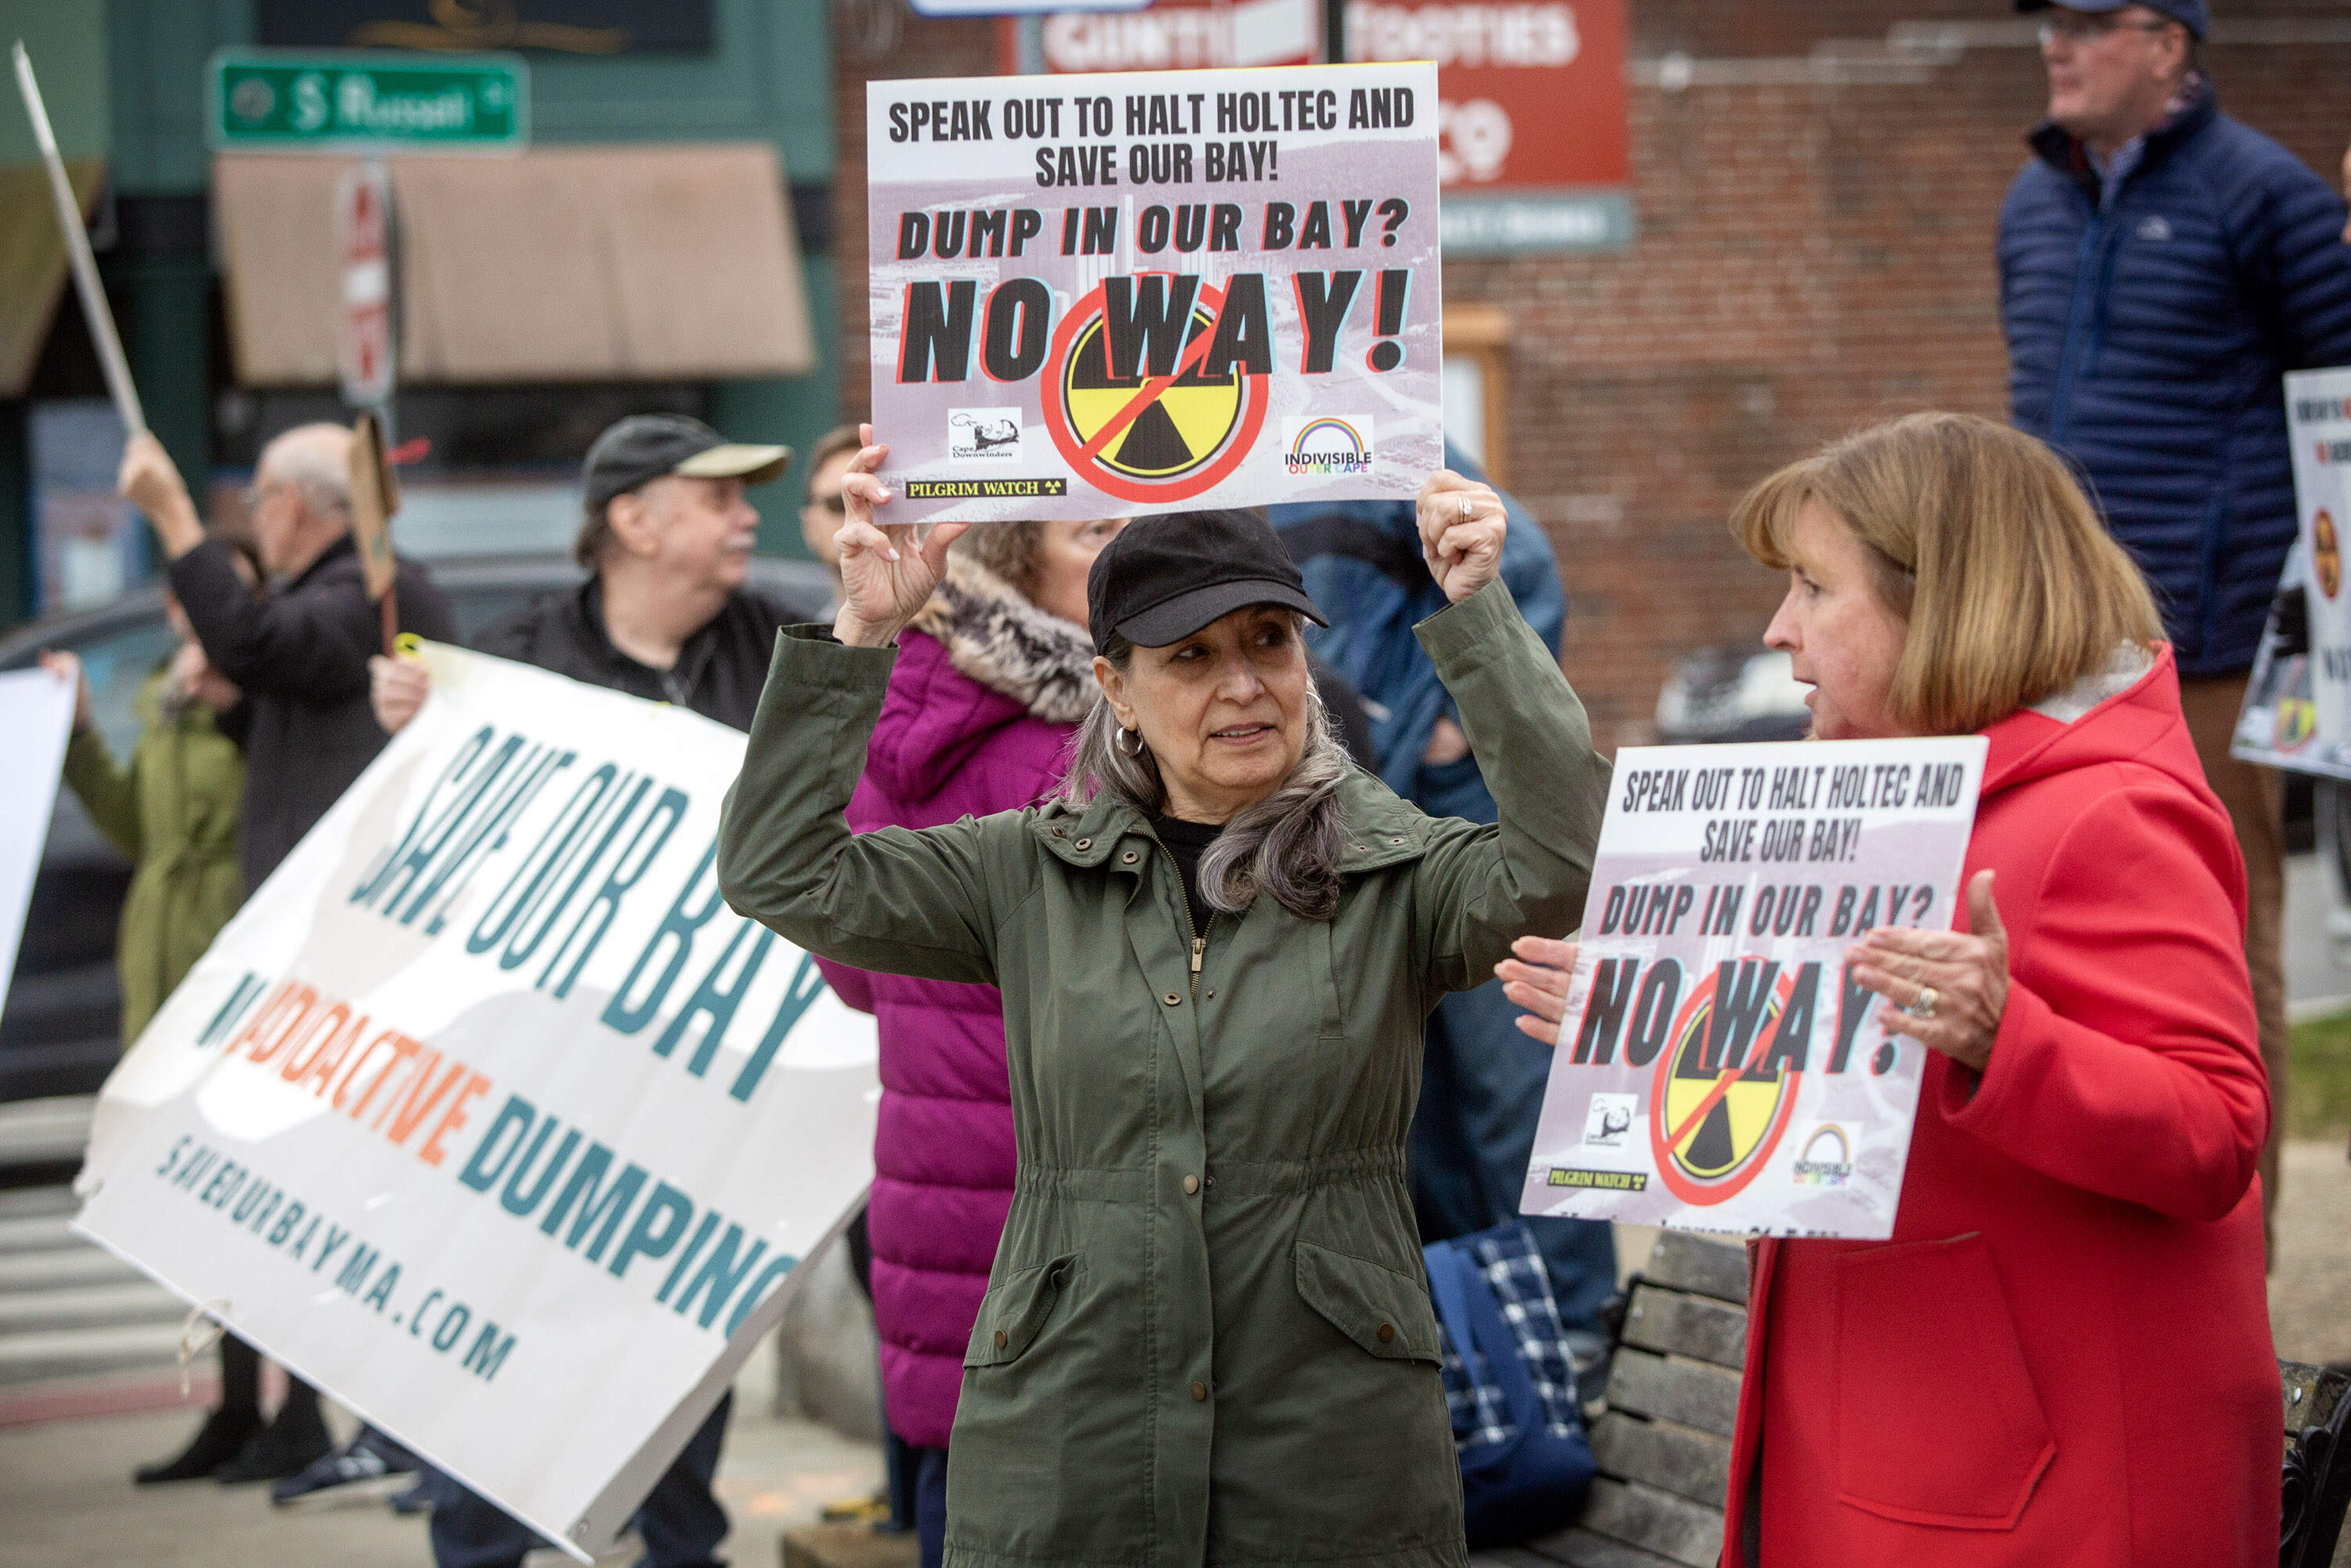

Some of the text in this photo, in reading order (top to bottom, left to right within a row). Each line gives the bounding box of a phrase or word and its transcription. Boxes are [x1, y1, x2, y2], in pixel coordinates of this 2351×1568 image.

[889, 87, 1415, 143] SPEAK OUT TO HALT HOLTEC AND
[1035, 140, 1279, 187] SAVE OUR BAY!
[896, 208, 1043, 260] DUMP
[1060, 205, 1119, 257] IN
[1137, 201, 1243, 253] OUR
[1261, 197, 1411, 252] BAY?
[896, 268, 1414, 385] NO WAY!
[1285, 452, 1371, 465] INDIVISIBLE
[1289, 462, 1367, 474] OUTER CAPE
[910, 480, 1039, 497] PILGRIM WATCH
[1622, 762, 1965, 813] SPEAK OUT TO HALT HOLTEC AND
[1701, 817, 1862, 863] SAVE OUR BAY!
[350, 726, 828, 1103] SAVE OUR BAY
[1598, 884, 1936, 937] DUMP IN OUR BAY?
[1569, 957, 1684, 1068] NO
